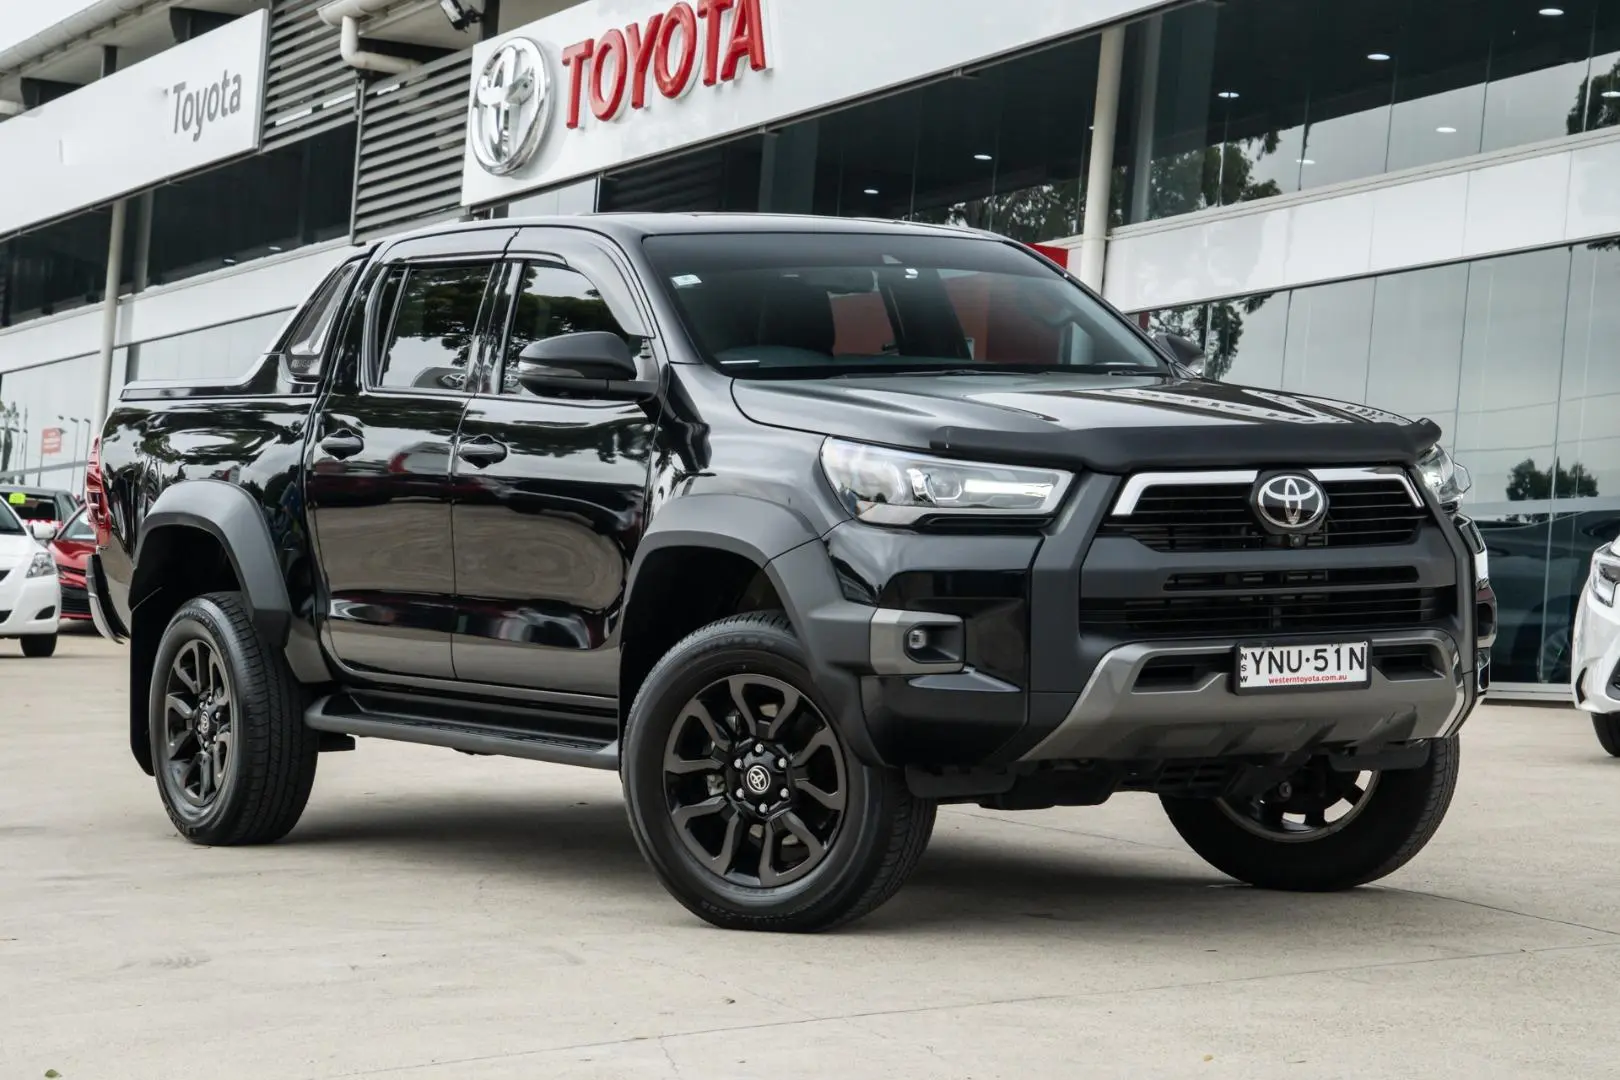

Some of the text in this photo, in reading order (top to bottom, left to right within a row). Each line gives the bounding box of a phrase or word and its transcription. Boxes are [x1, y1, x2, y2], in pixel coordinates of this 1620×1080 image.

[562, 0, 766, 129] TOYOTA
[173, 69, 242, 142] Toyota
[1268, 674, 1348, 684] westerntoyota.com.au
